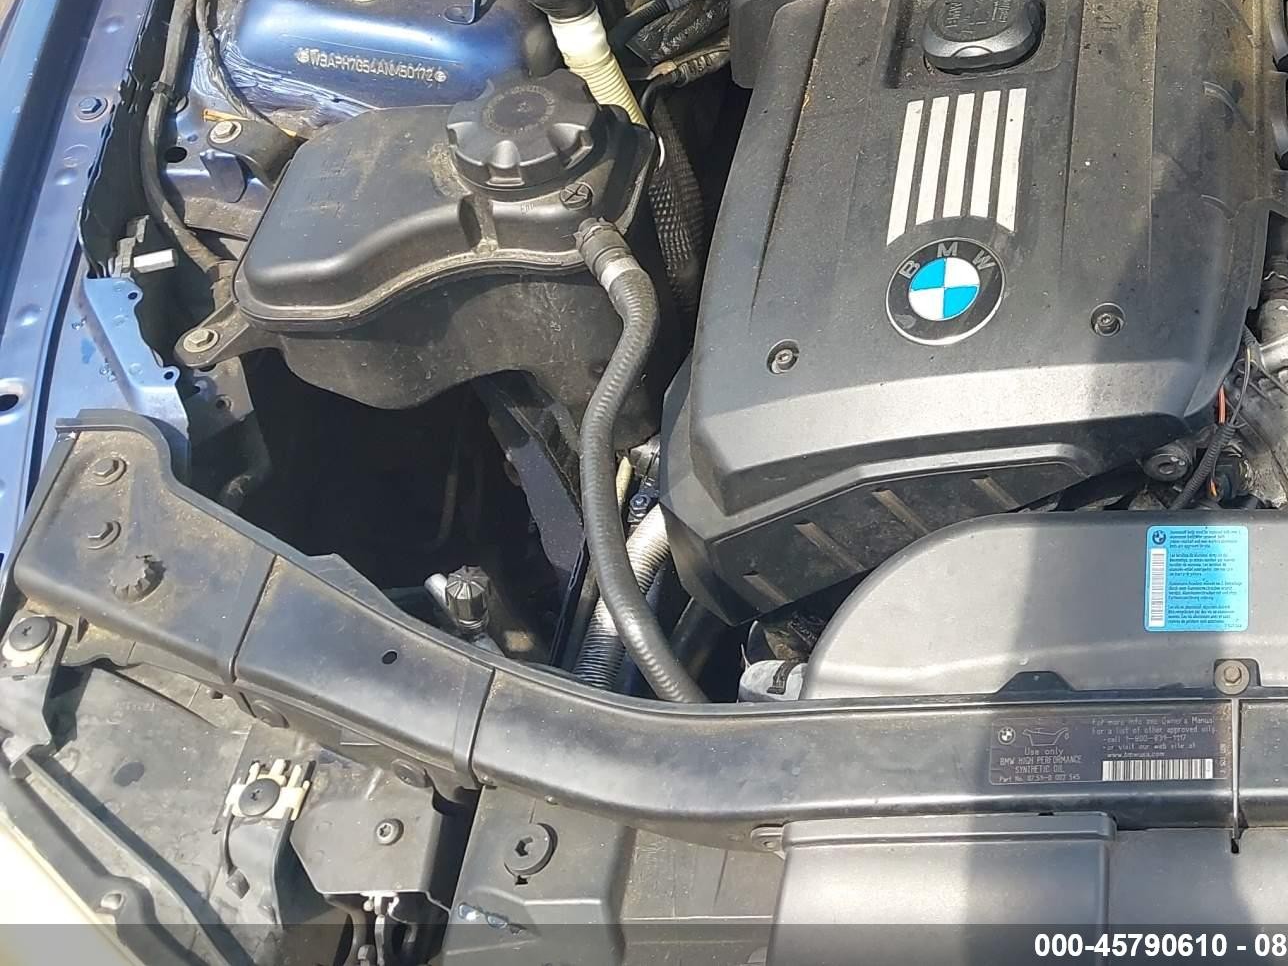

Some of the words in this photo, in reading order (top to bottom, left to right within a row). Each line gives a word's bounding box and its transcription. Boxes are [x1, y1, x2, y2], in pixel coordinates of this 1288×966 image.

[899, 241, 996, 279] BMW
[1024, 746, 1040, 756] Use
[1044, 746, 1064, 756] only
[1000, 756, 1015, 766] BMW
[1018, 756, 1034, 765] HIGH
[1036, 754, 1082, 765] PERFORMANCE
[1015, 765, 1050, 774] SYNTHETIC
[1053, 764, 1065, 773] OIL
